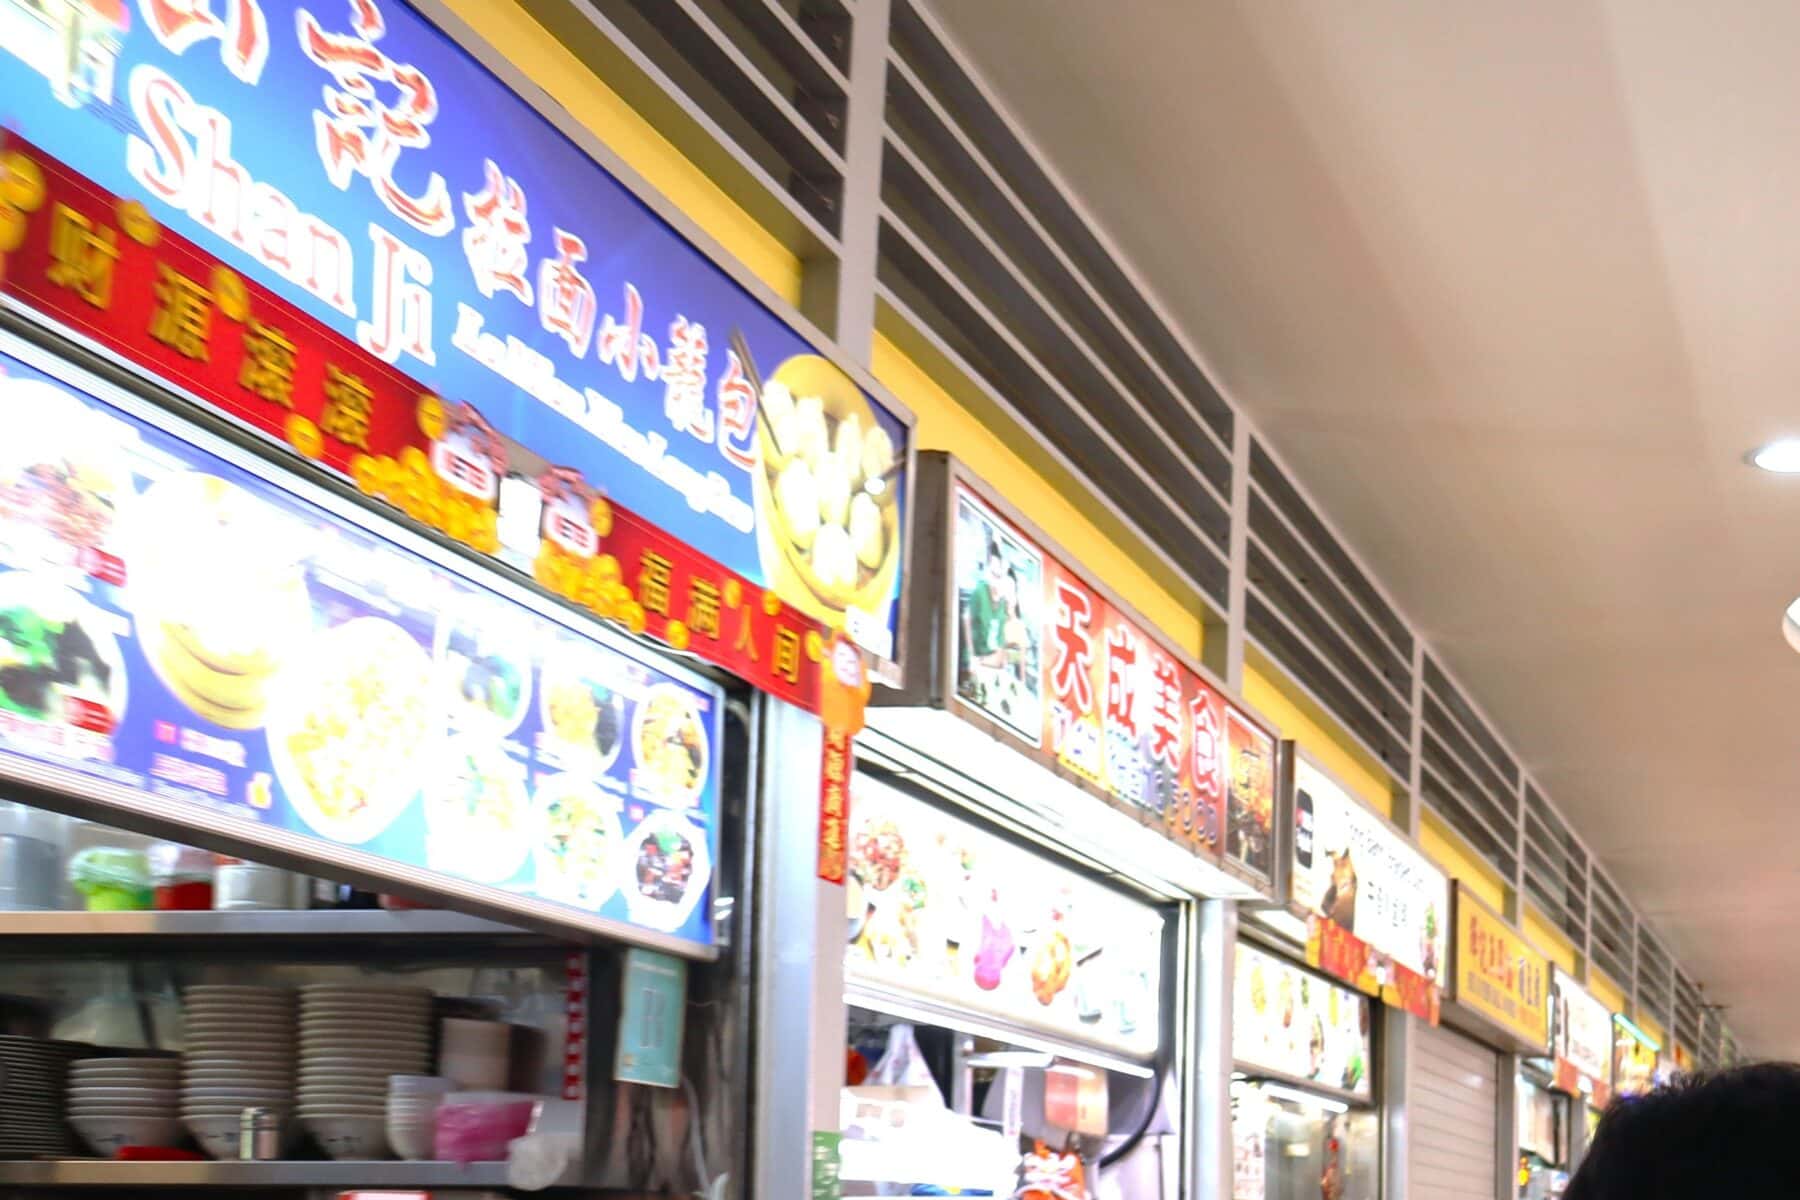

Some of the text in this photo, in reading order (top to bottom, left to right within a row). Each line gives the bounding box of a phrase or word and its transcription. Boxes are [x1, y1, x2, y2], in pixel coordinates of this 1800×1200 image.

[127, 64, 356, 318] Shan
[357, 223, 436, 366] Ji
[1050, 582, 1222, 798] 天成美食
